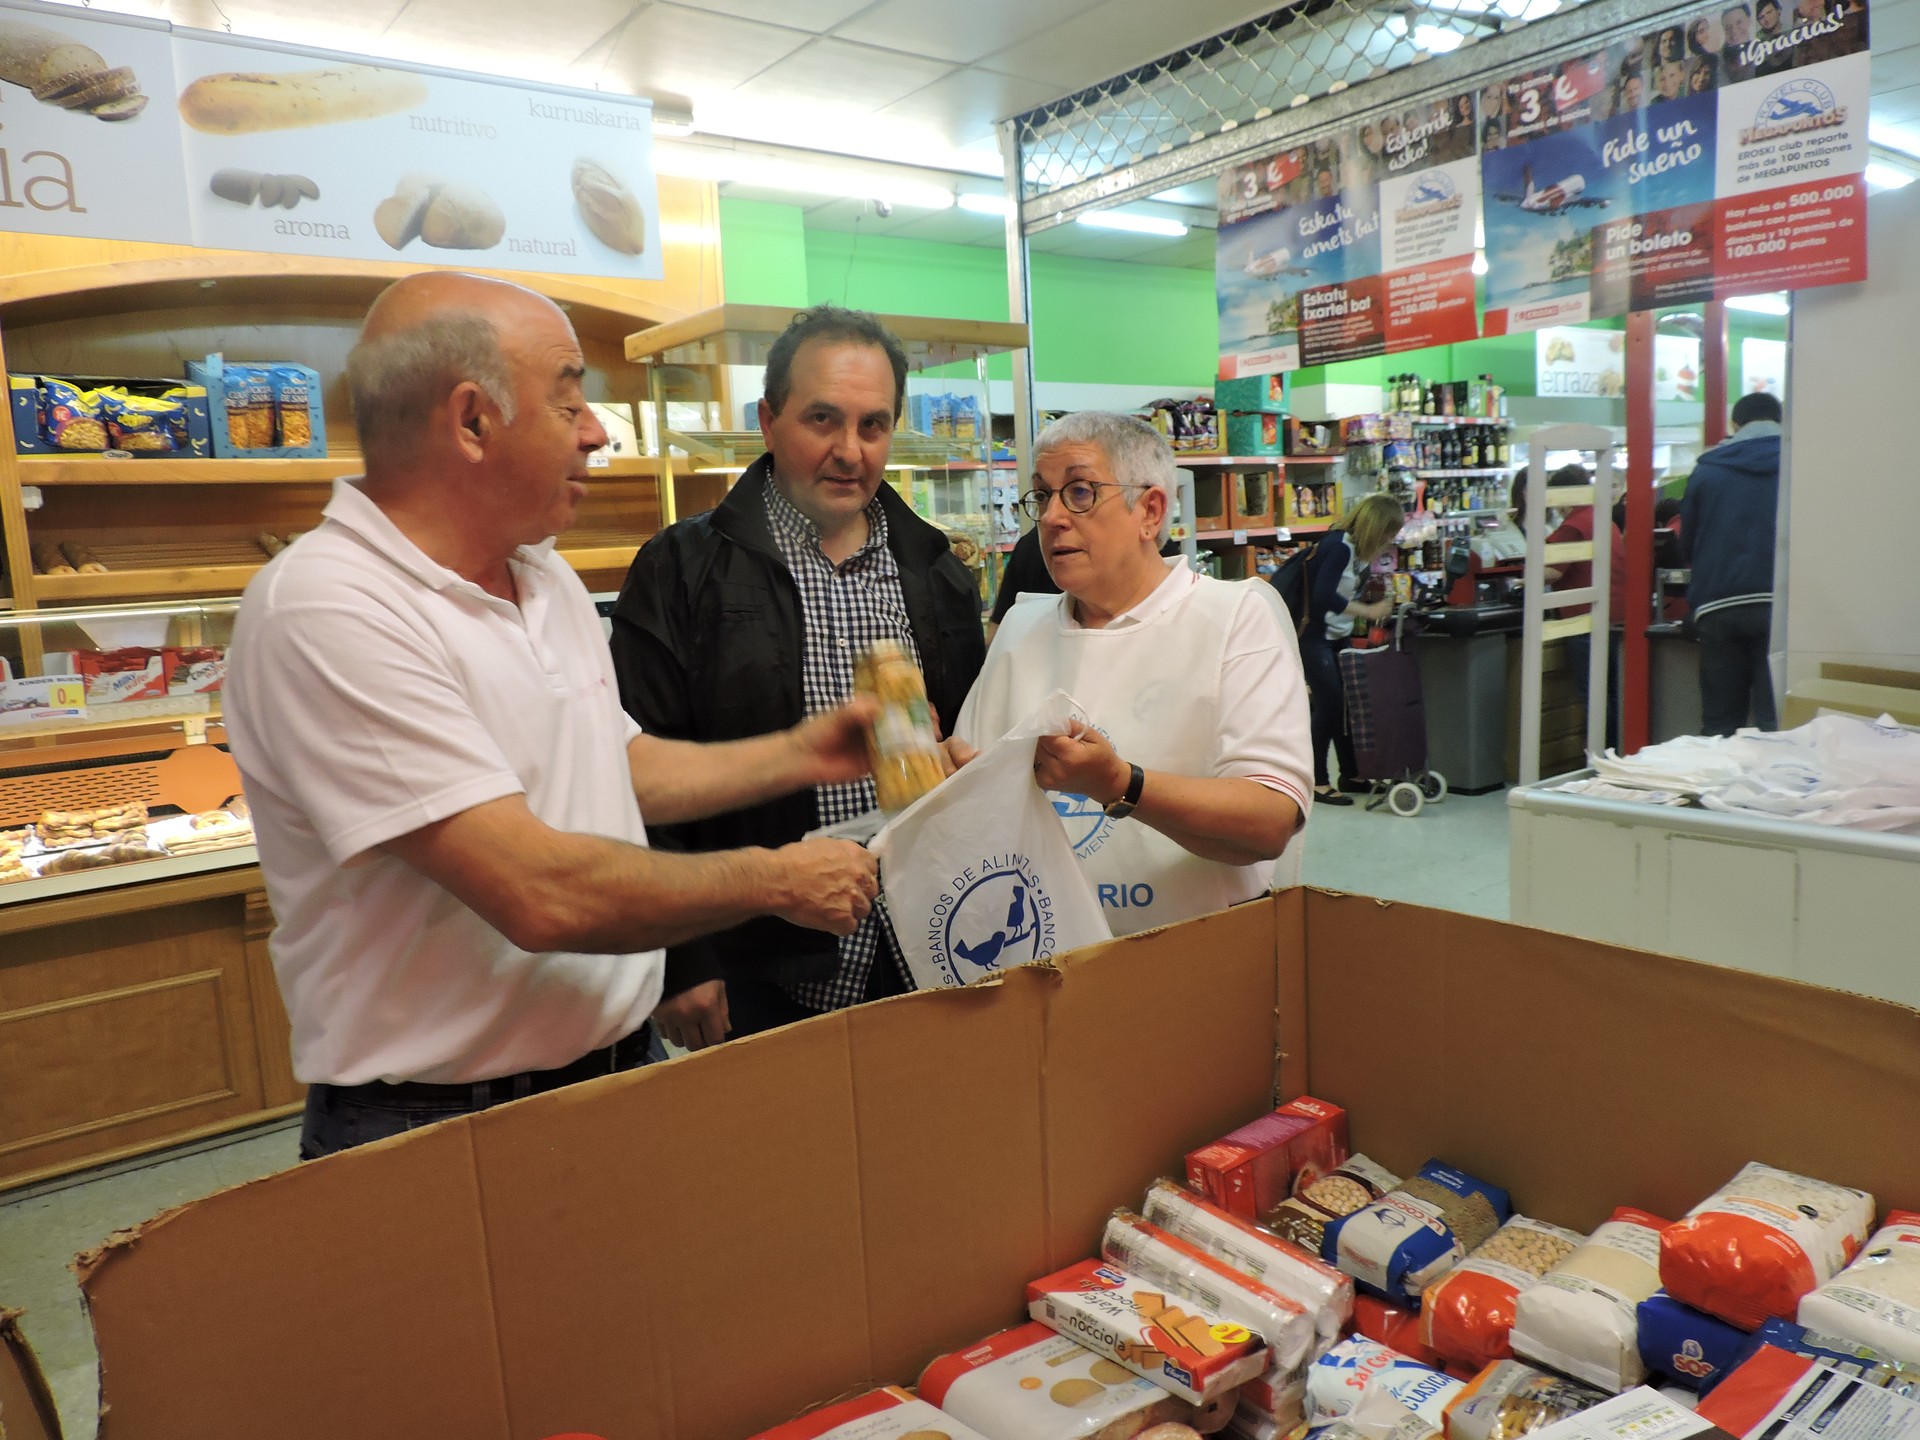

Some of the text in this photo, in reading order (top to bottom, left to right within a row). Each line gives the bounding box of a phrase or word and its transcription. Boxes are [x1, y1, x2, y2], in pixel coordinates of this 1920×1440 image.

[1740, 4, 1844, 66] ¡Gracias!
[528, 98, 641, 132] kurruskaria
[1520, 89, 1541, 123] 3
[409, 114, 498, 140] nutritivo
[1602, 120, 1699, 168] Pide un
[1738, 132, 1849, 161] EROSKI club reparte
[1763, 157, 1777, 167] de
[1781, 152, 1801, 163] 100
[1804, 143, 1853, 158] millones
[1628, 141, 1702, 185] sueño
[1754, 158, 1831, 180] MEGAPUNTOS
[1244, 171, 1259, 199] 3
[1788, 184, 1855, 207] 500.000
[274, 218, 351, 240] aroma
[1299, 203, 1355, 236] Eskatu
[1606, 223, 1643, 244] Pide
[508, 236, 577, 257] natural
[1303, 210, 1379, 259] amets bat
[1606, 229, 1693, 261] un boleto
[1726, 238, 1787, 259] 100.000
[1303, 288, 1348, 307] Eskatu
[1303, 295, 1371, 320] txartel bat
[928, 893, 955, 964] BANCOS
[952, 867, 976, 891] DE
[1077, 1292, 1123, 1317] Wafer
[1079, 1280, 1144, 1310] nocciola
[1069, 1316, 1126, 1351] nocciola
[1345, 1364, 1374, 1391] Sal
[1400, 1372, 1455, 1411] CLASICA
